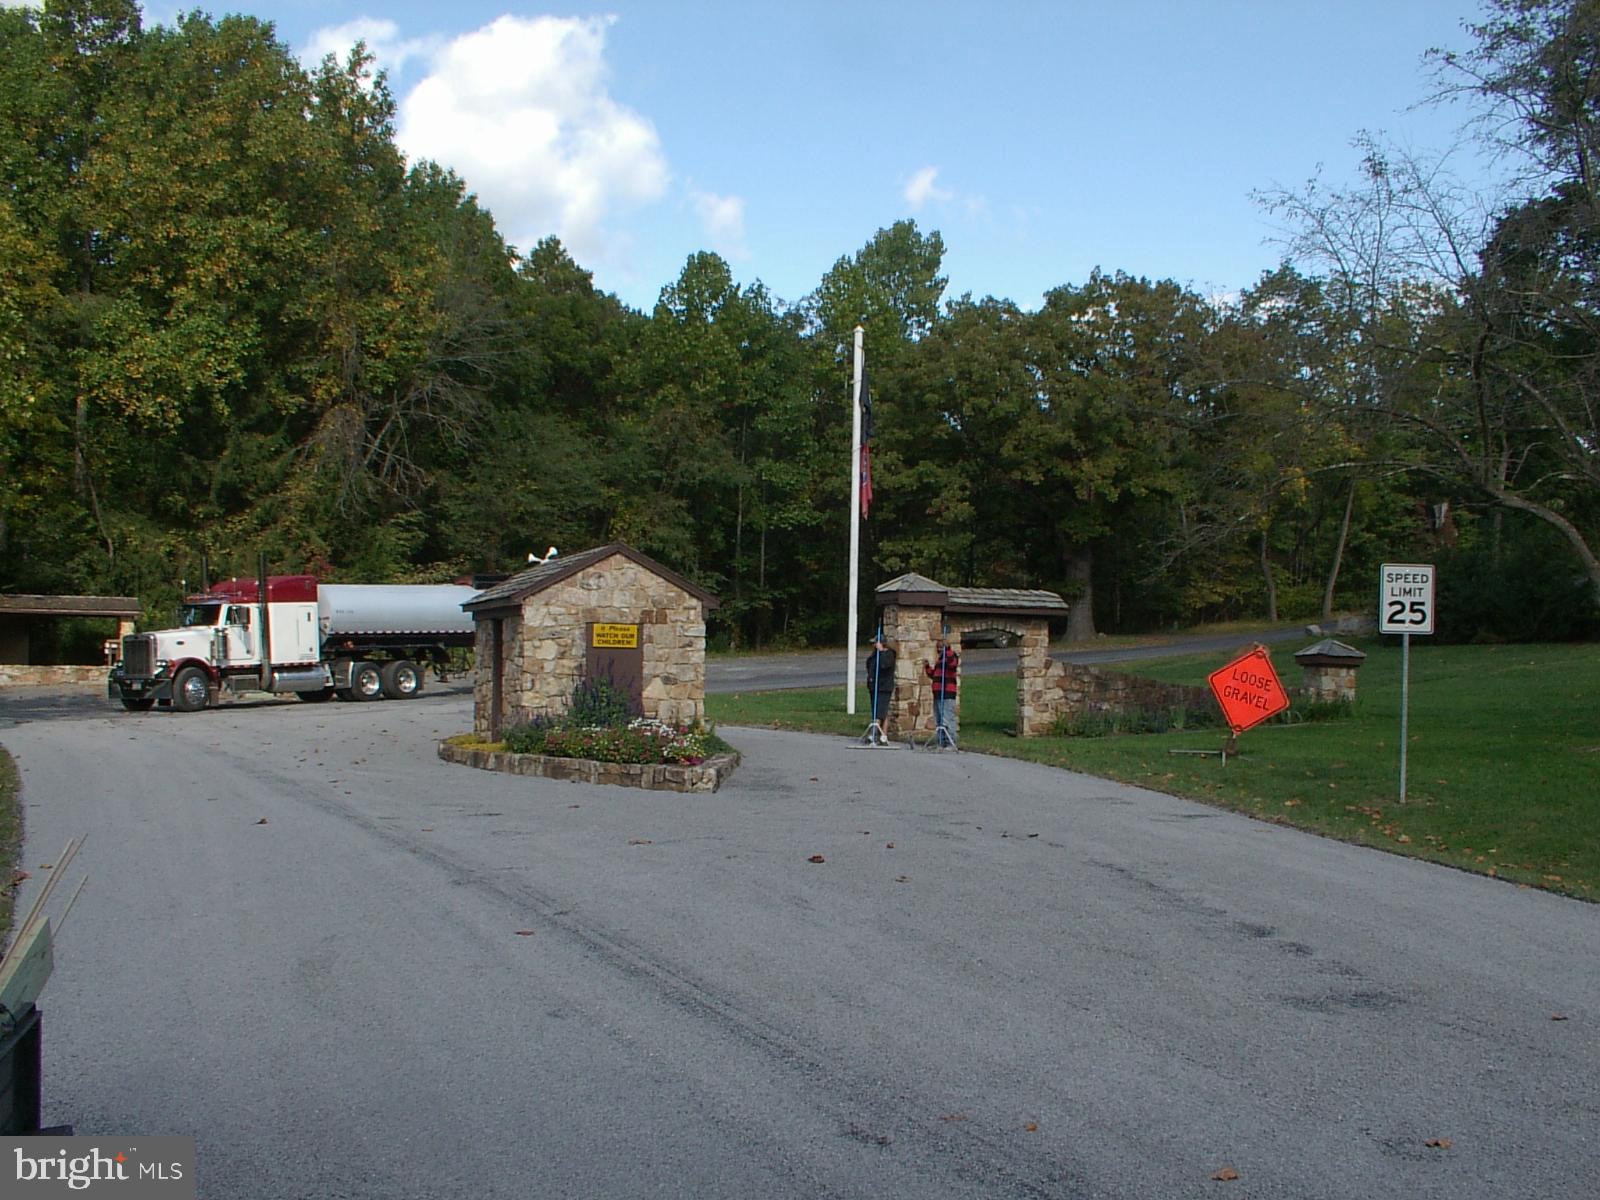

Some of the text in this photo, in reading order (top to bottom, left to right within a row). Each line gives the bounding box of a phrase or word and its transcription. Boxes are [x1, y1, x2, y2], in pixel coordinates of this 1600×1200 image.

[1386, 572, 1429, 584] SPEED
[1391, 587, 1424, 597] LIMIT
[1387, 600, 1427, 625] 25
[1232, 668, 1273, 692] LOOSE
[1223, 685, 1270, 711] GRAVEL
